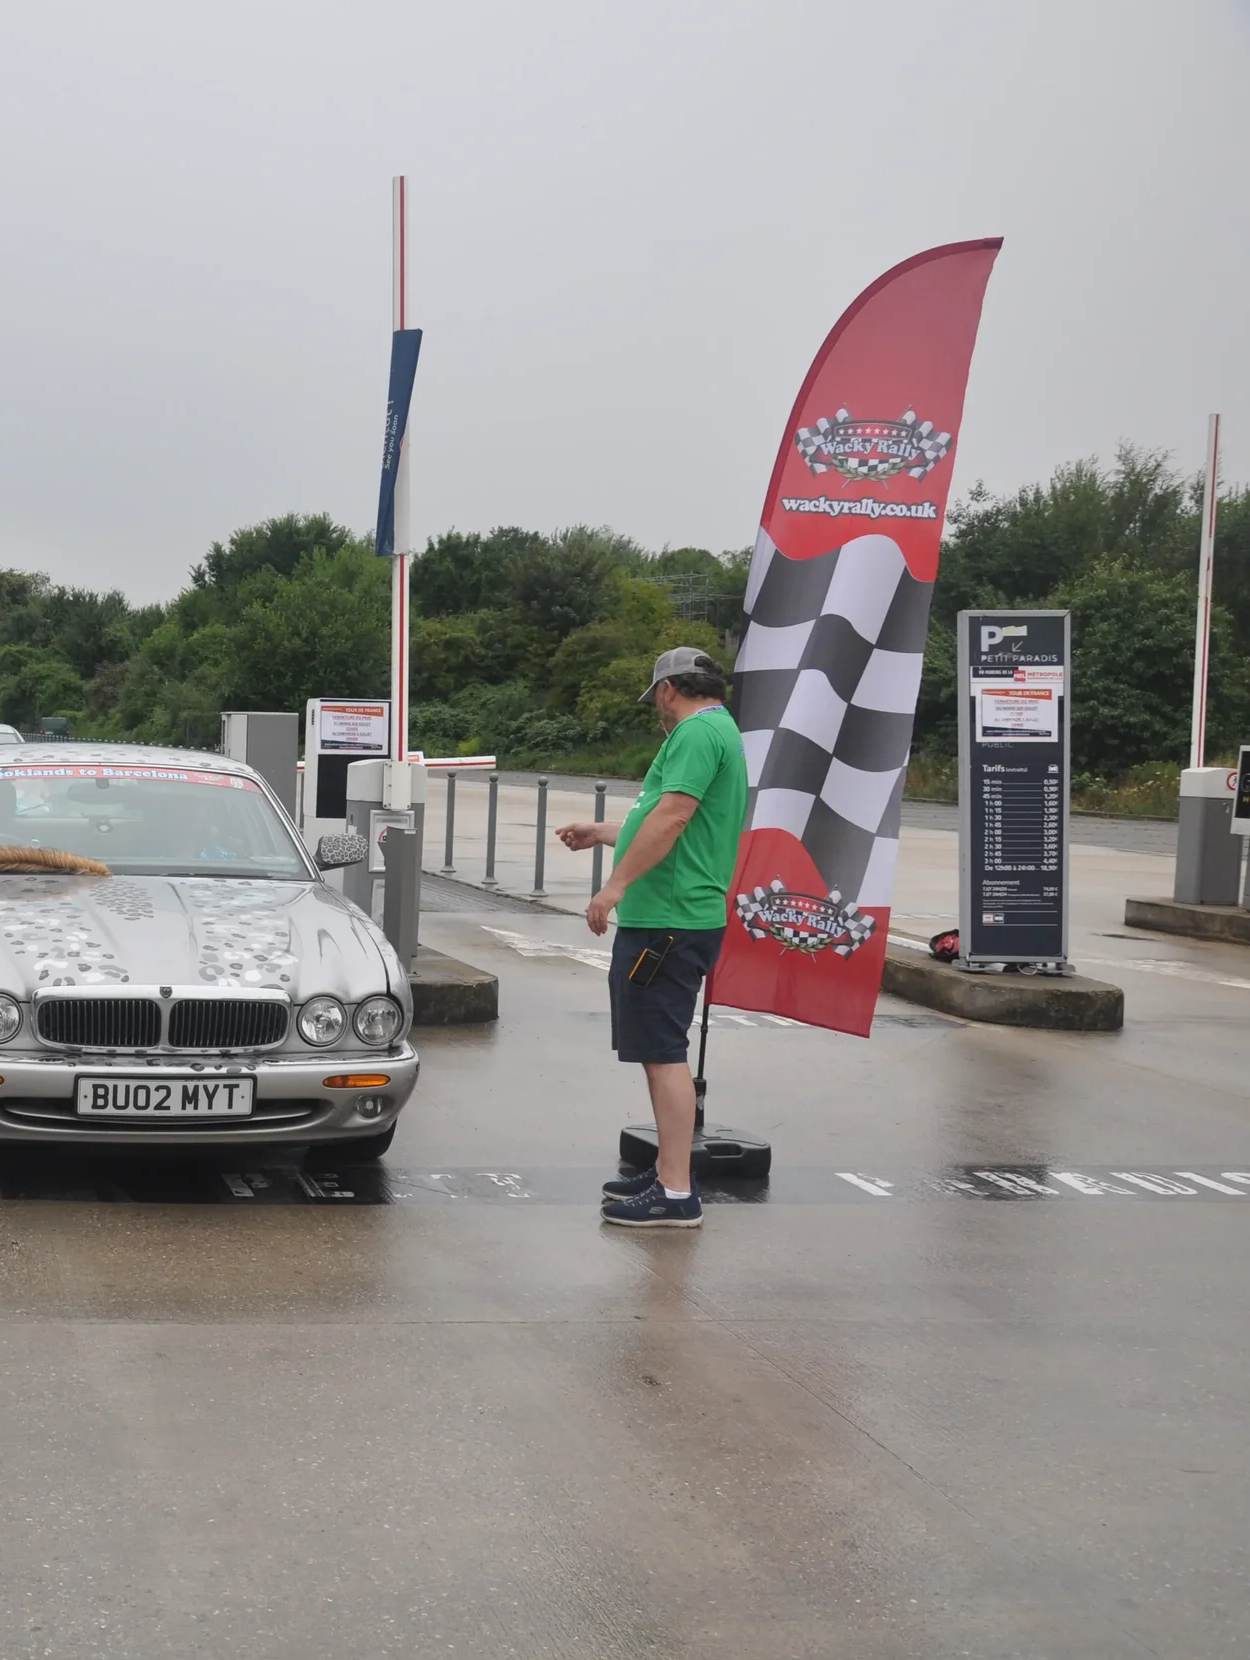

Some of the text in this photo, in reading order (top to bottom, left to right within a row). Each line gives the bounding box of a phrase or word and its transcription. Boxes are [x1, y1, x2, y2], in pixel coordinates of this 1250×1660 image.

[820, 439, 921, 460] Wacky Rally
[781, 496, 937, 518] wackyrally.co.uk
[981, 654, 1058, 662] PETIT PARADIS
[78, 768, 97, 776] to
[102, 768, 189, 780] Barcelona
[758, 908, 847, 938] Wacky Rally
[180, 1083, 240, 1111] MYT
